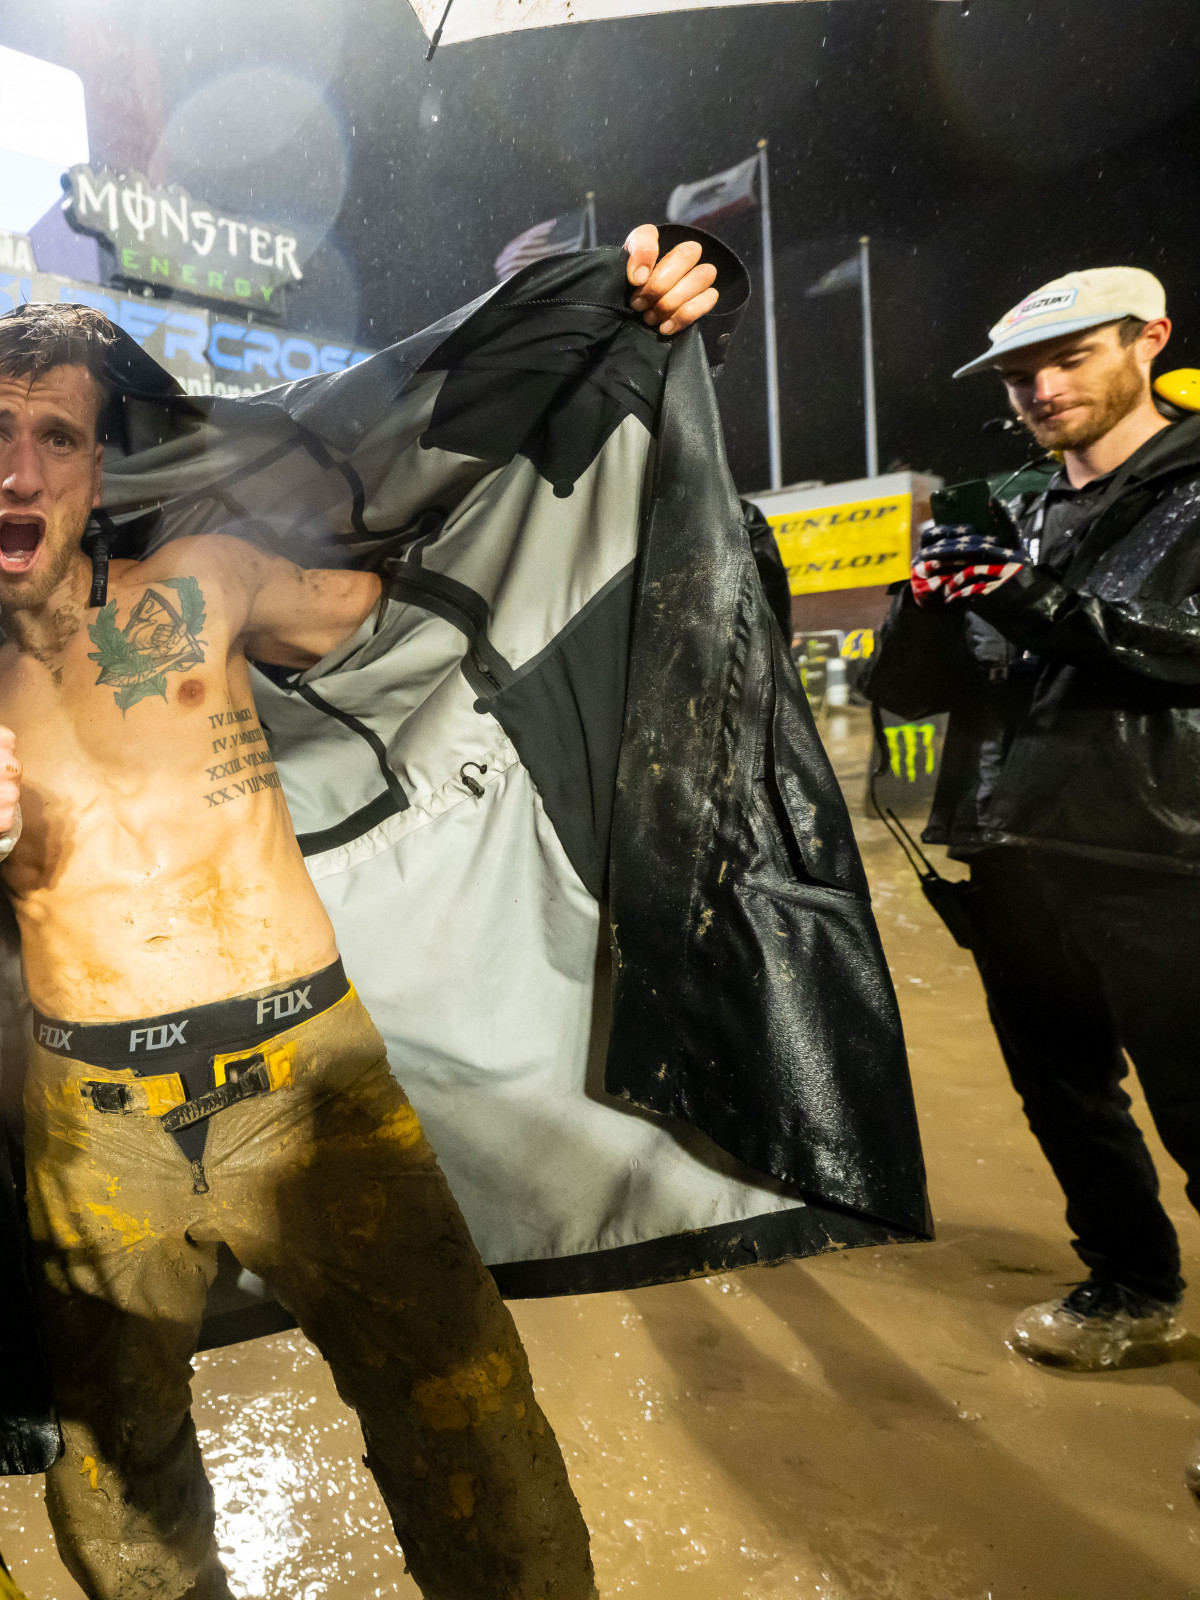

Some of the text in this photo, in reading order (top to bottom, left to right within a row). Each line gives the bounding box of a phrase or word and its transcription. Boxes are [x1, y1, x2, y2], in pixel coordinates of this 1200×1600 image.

[76, 173, 303, 280] MONSTER
[121, 248, 274, 302] ENERGY
[771, 505, 899, 535] UNLOP
[784, 551, 899, 578] UNLOP
[255, 985, 314, 1025] FOX
[38, 1023, 74, 1051] FOX
[129, 1019, 190, 1053] FOX
